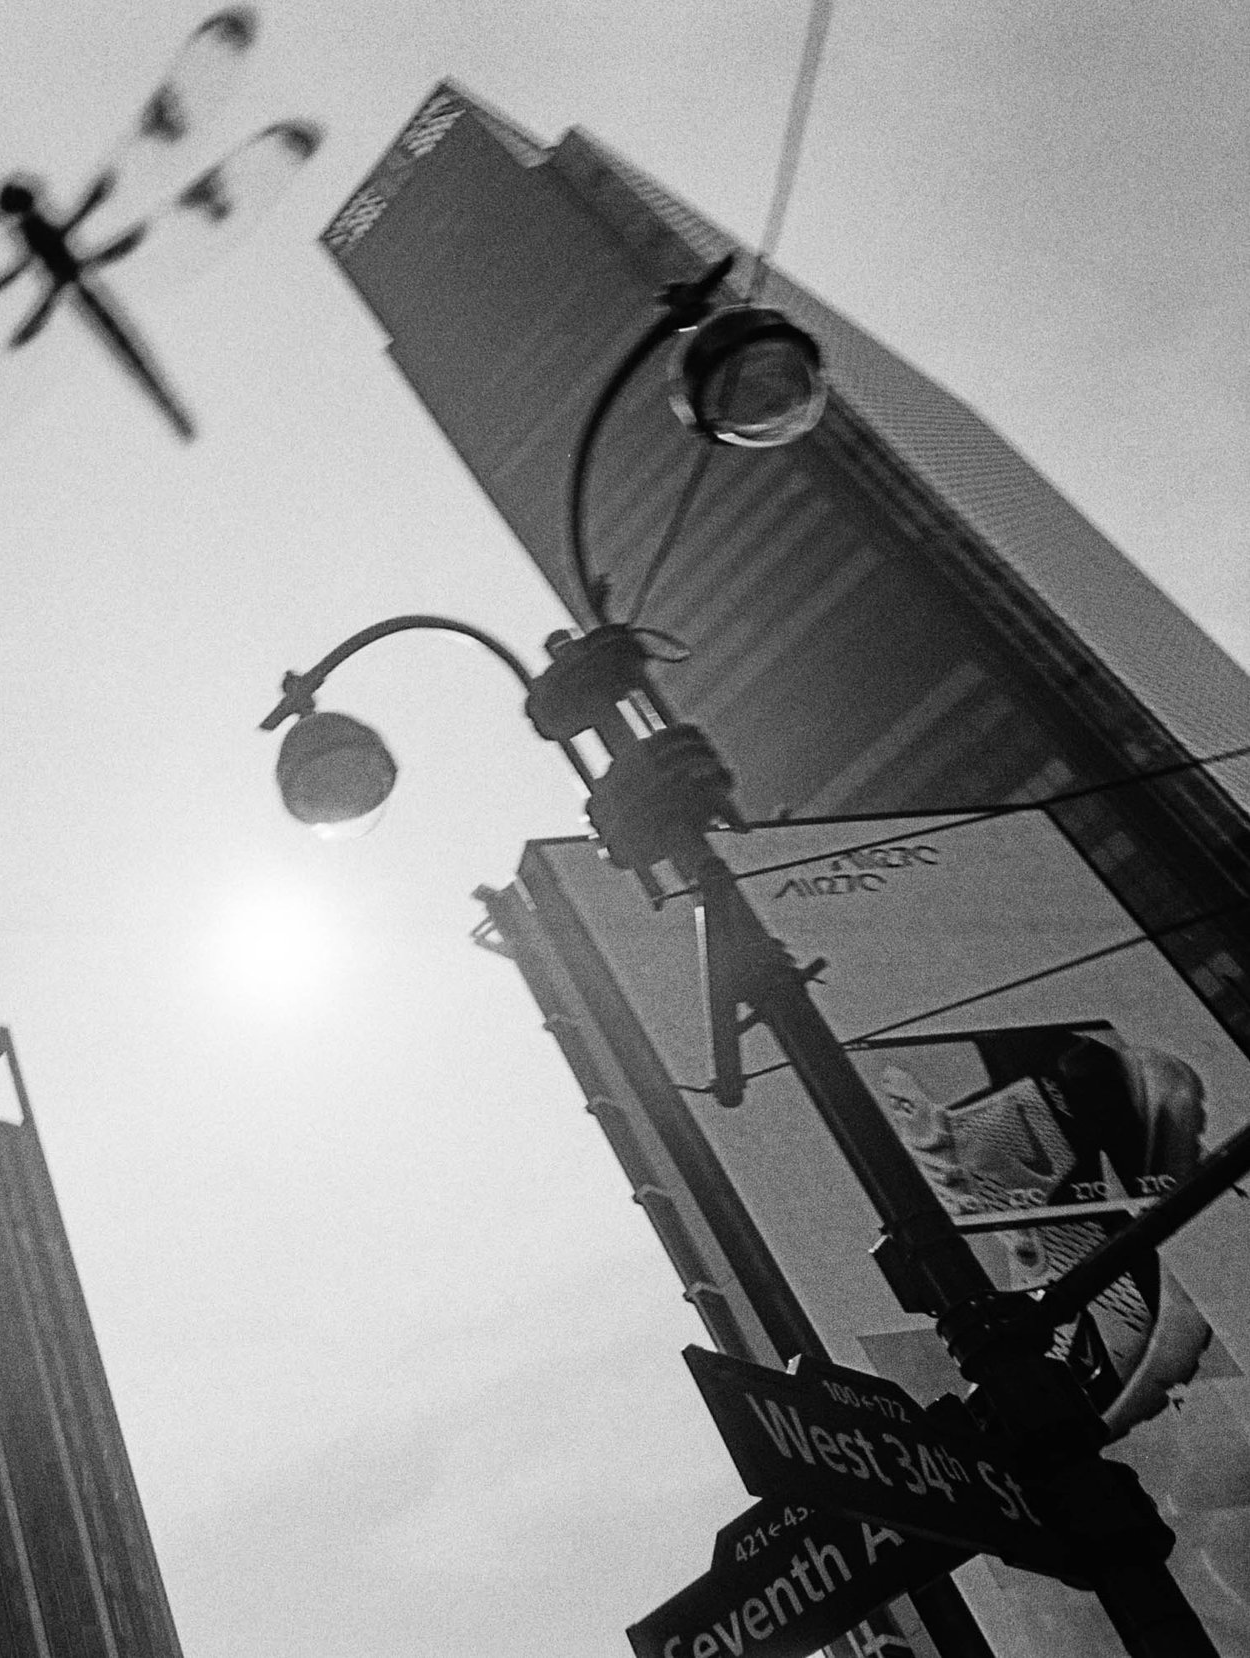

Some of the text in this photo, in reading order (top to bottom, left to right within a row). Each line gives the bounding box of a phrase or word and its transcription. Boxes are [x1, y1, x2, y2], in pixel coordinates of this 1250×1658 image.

[744, 1391, 1042, 1527] West 34th St
[735, 1526, 769, 1562] 421
